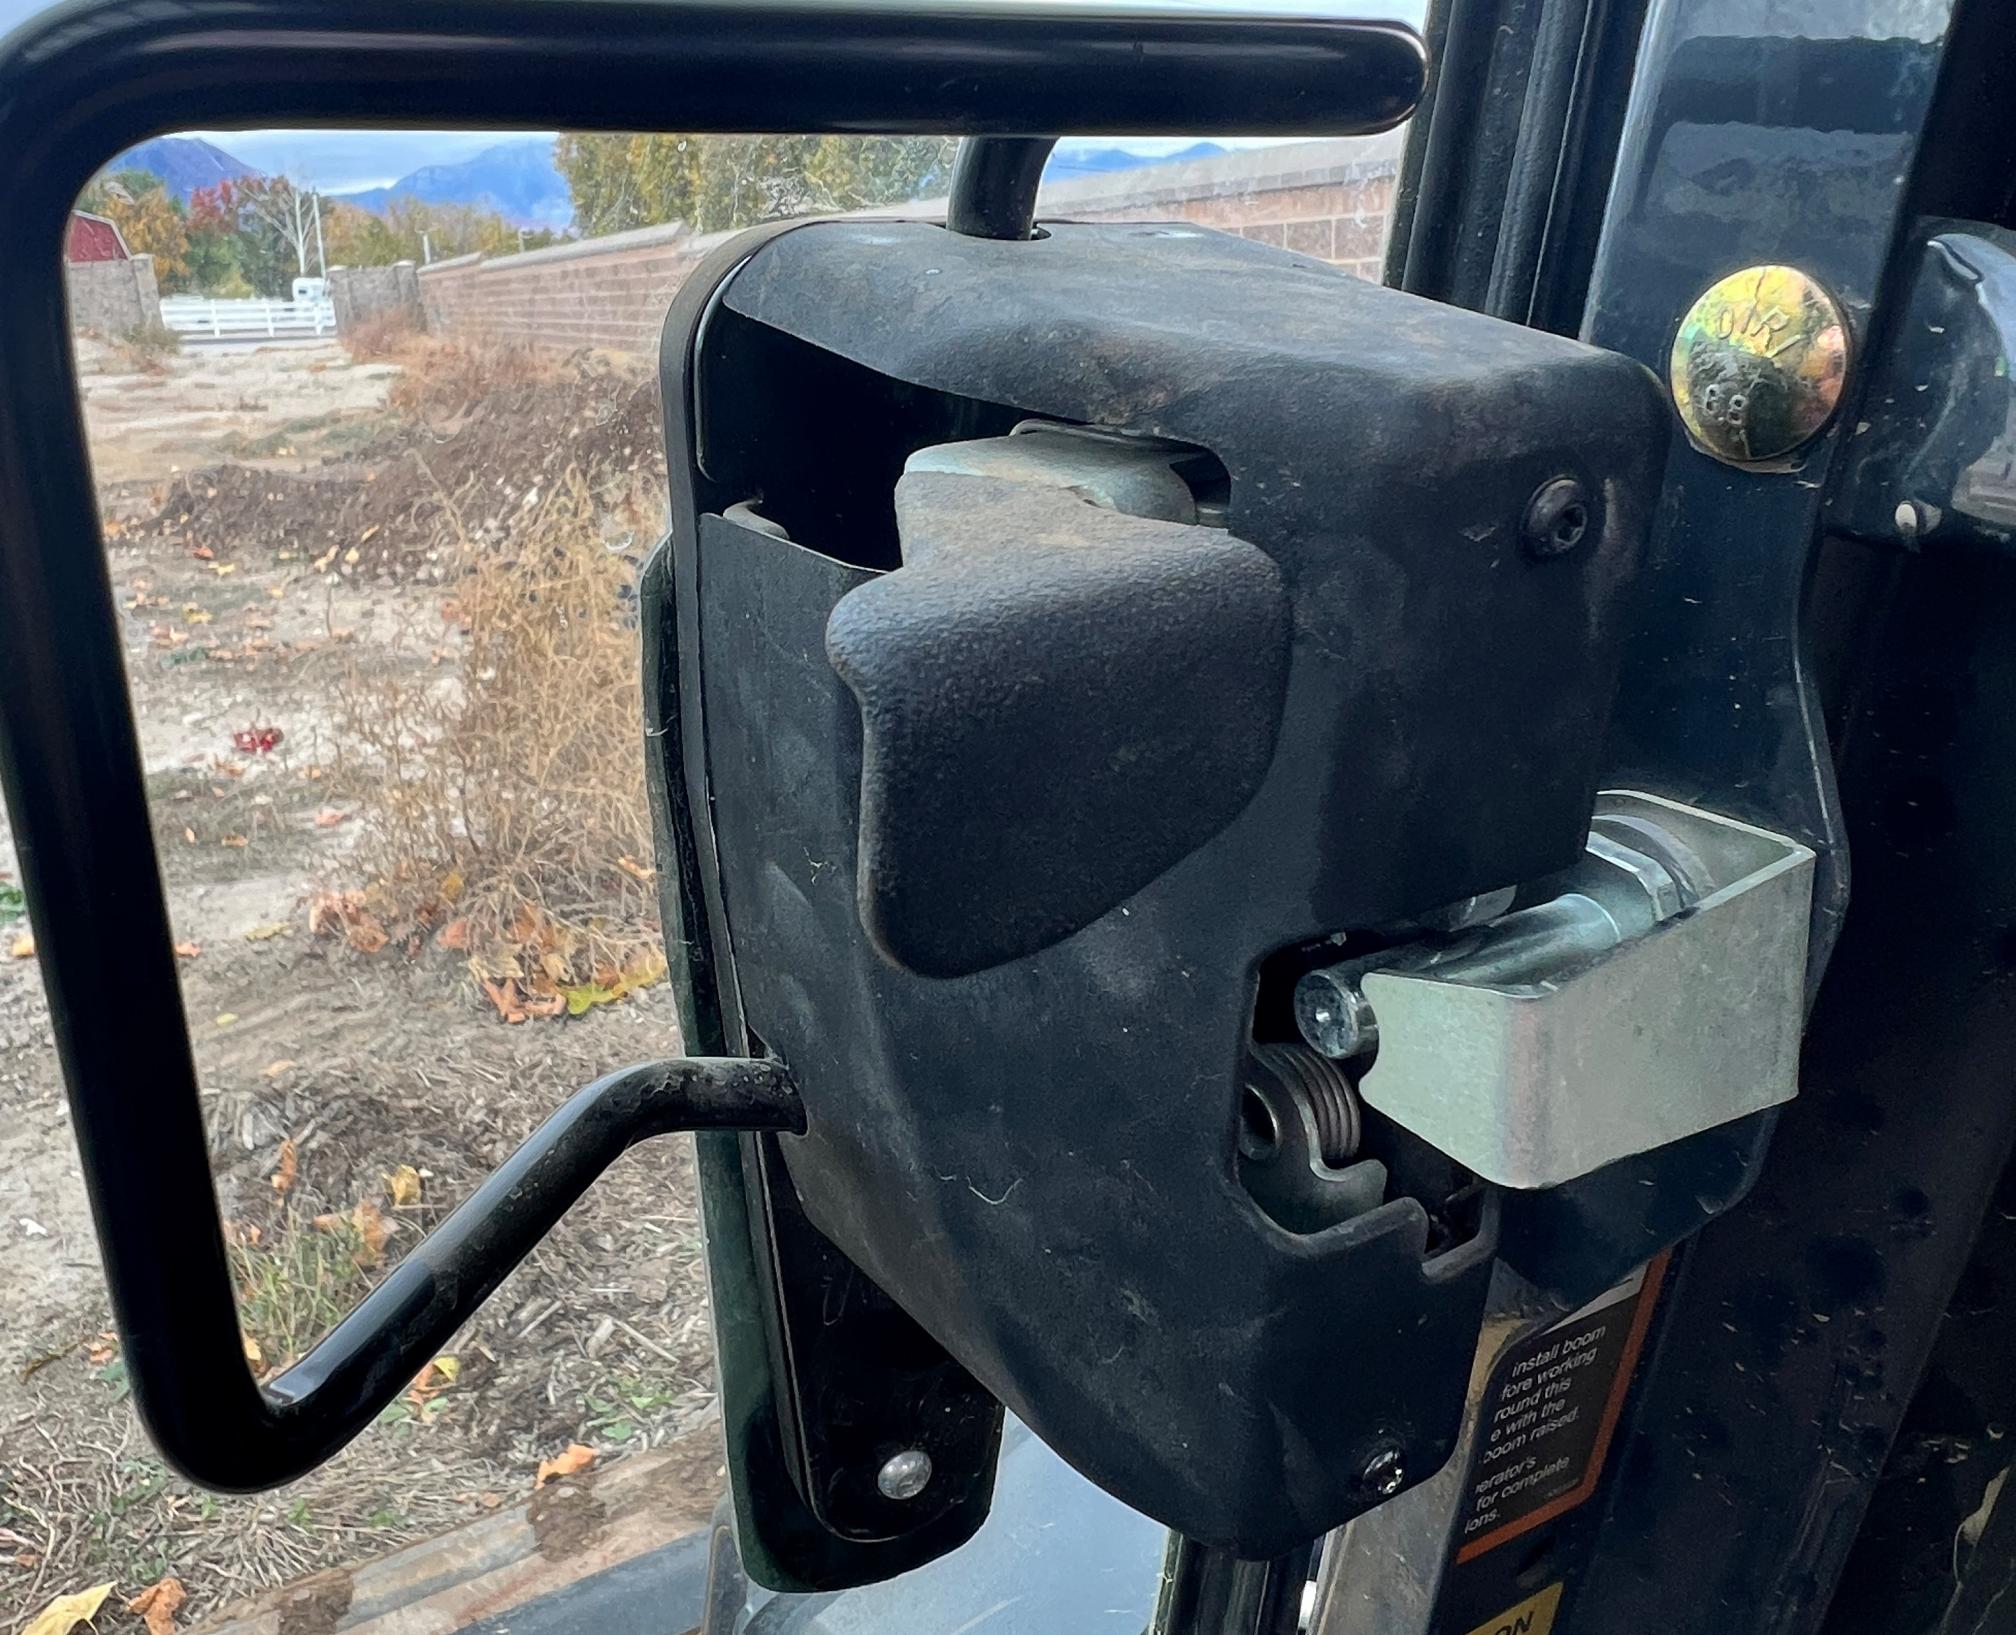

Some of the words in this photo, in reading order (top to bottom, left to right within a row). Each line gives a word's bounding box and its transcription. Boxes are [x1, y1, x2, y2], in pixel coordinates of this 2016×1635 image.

[1512, 1343, 1559, 1377] install
[1562, 1326, 1606, 1354] boom
[1500, 1378, 1533, 1401] fore
[1537, 1347, 1598, 1384] working
[1544, 1377, 1572, 1399] this
[1506, 1410, 1536, 1435] with
[1541, 1398, 1566, 1418] the
[1529, 1406, 1579, 1441] raised.
[1476, 1491, 1497, 1512] for
[1501, 1456, 1570, 1499] complete
